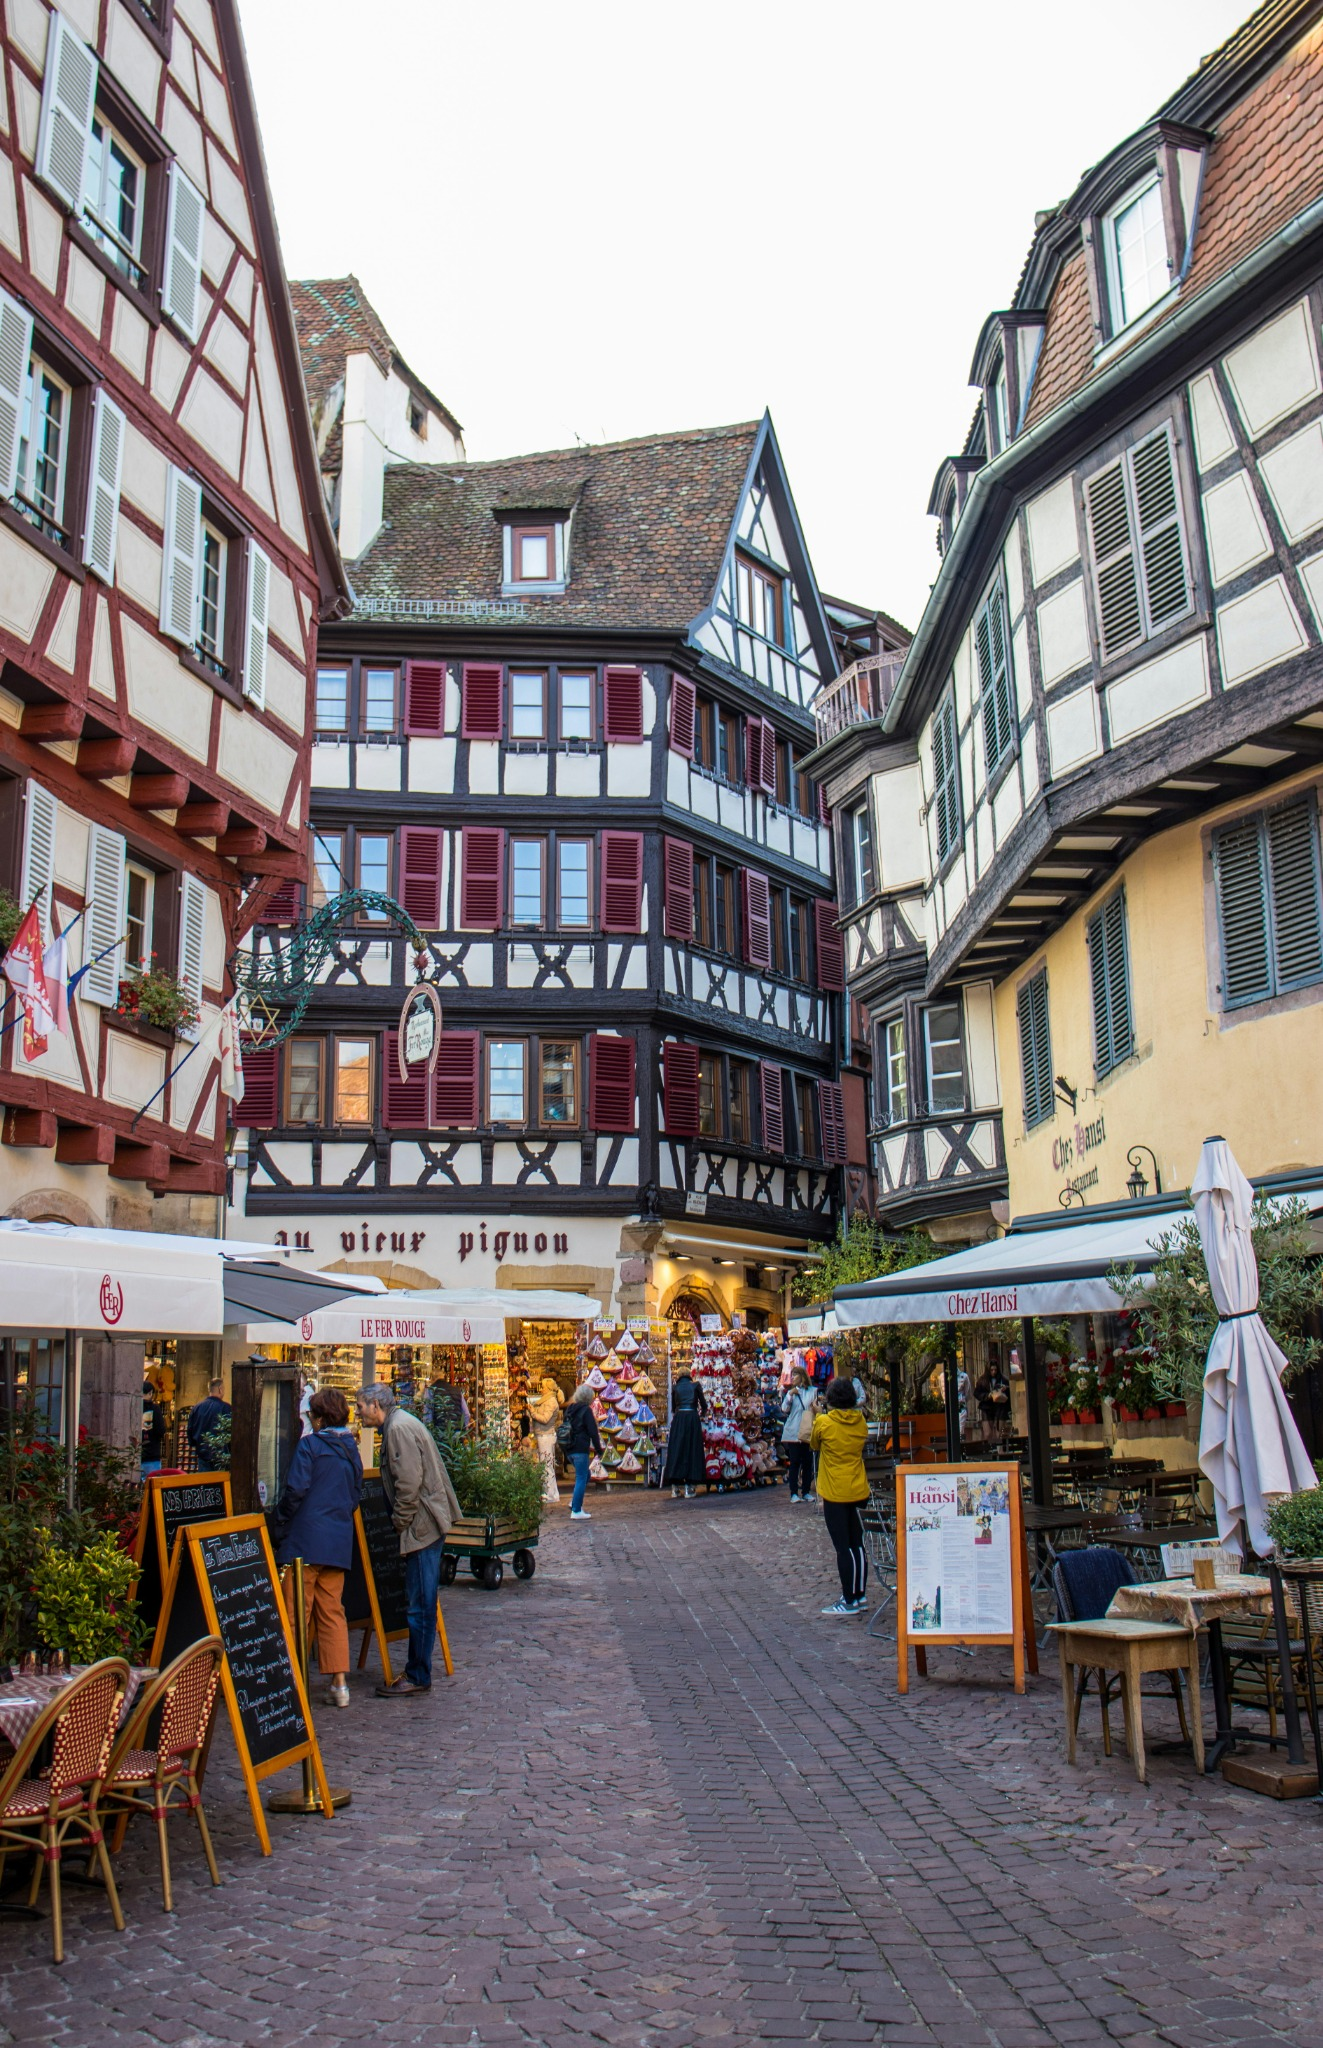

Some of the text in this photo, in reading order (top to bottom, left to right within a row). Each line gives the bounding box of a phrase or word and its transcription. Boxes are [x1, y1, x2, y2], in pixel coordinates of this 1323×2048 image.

[1052, 1109, 1106, 1174] Chez Hansi
[275, 1221, 569, 1263] au vieux pignon
[948, 1288, 1018, 1316] Chez Hansi
[361, 1319, 426, 1339] LE FER ROUGE
[163, 1490, 182, 1512] NOS
[909, 1489, 955, 1504] Hansi
